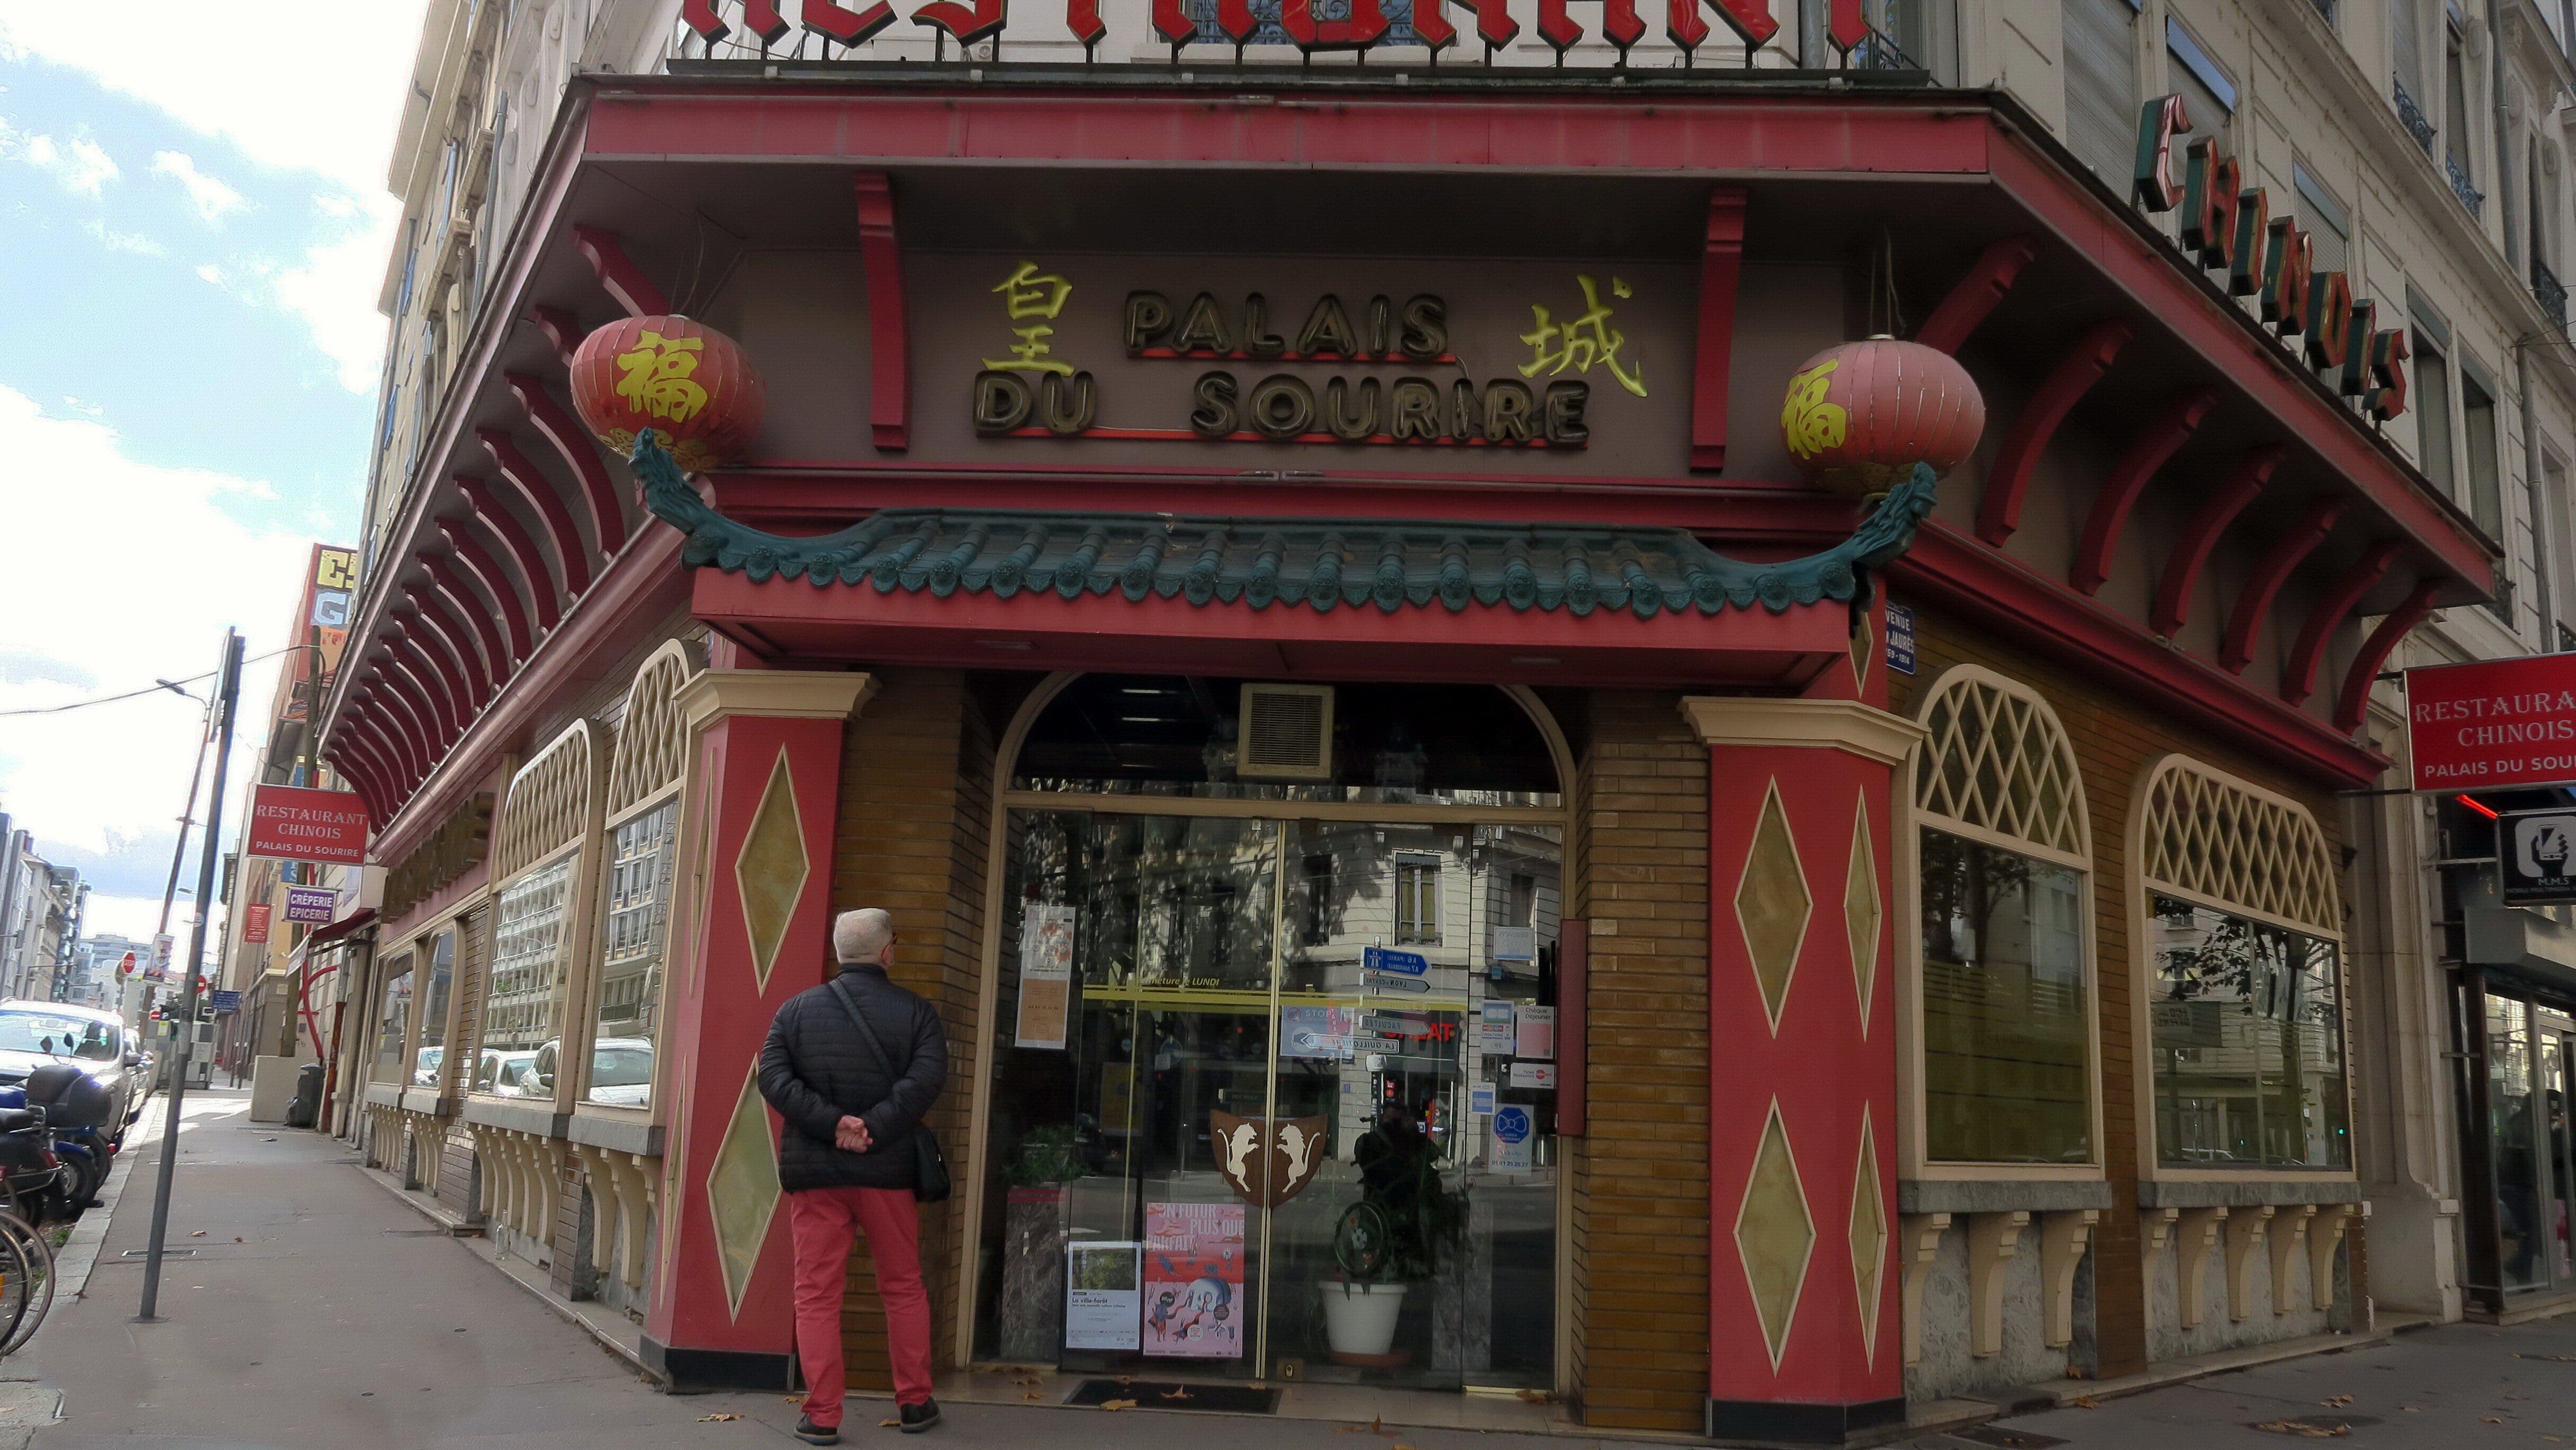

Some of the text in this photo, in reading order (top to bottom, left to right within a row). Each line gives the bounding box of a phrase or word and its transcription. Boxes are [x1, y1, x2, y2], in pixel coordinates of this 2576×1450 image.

[2136, 92, 2410, 422] CHINOIS
[982, 260, 1076, 377] 皇
[1123, 289, 1449, 358] PALAIS
[1515, 273, 1649, 398] 城
[616, 329, 708, 423] 福
[973, 369, 1591, 447] DU SOURIRE
[1885, 609, 1911, 632] VENUE
[2457, 719, 2574, 747] CHINOIS
[2425, 761, 2488, 778] PALAIS
[2495, 759, 2524, 773] DU
[256, 804, 367, 825] RESTAURANT
[278, 823, 342, 839] CHINOIS
[256, 841, 359, 857] PALAIS DU SOURIRE
[291, 893, 333, 908] CRÉPERIE
[290, 907, 330, 921] EPICERIE
[1192, 978, 1220, 986] LUNDI
[1179, 1204, 1217, 1219] FUTUR
[1190, 1218, 1219, 1235] PLUS
